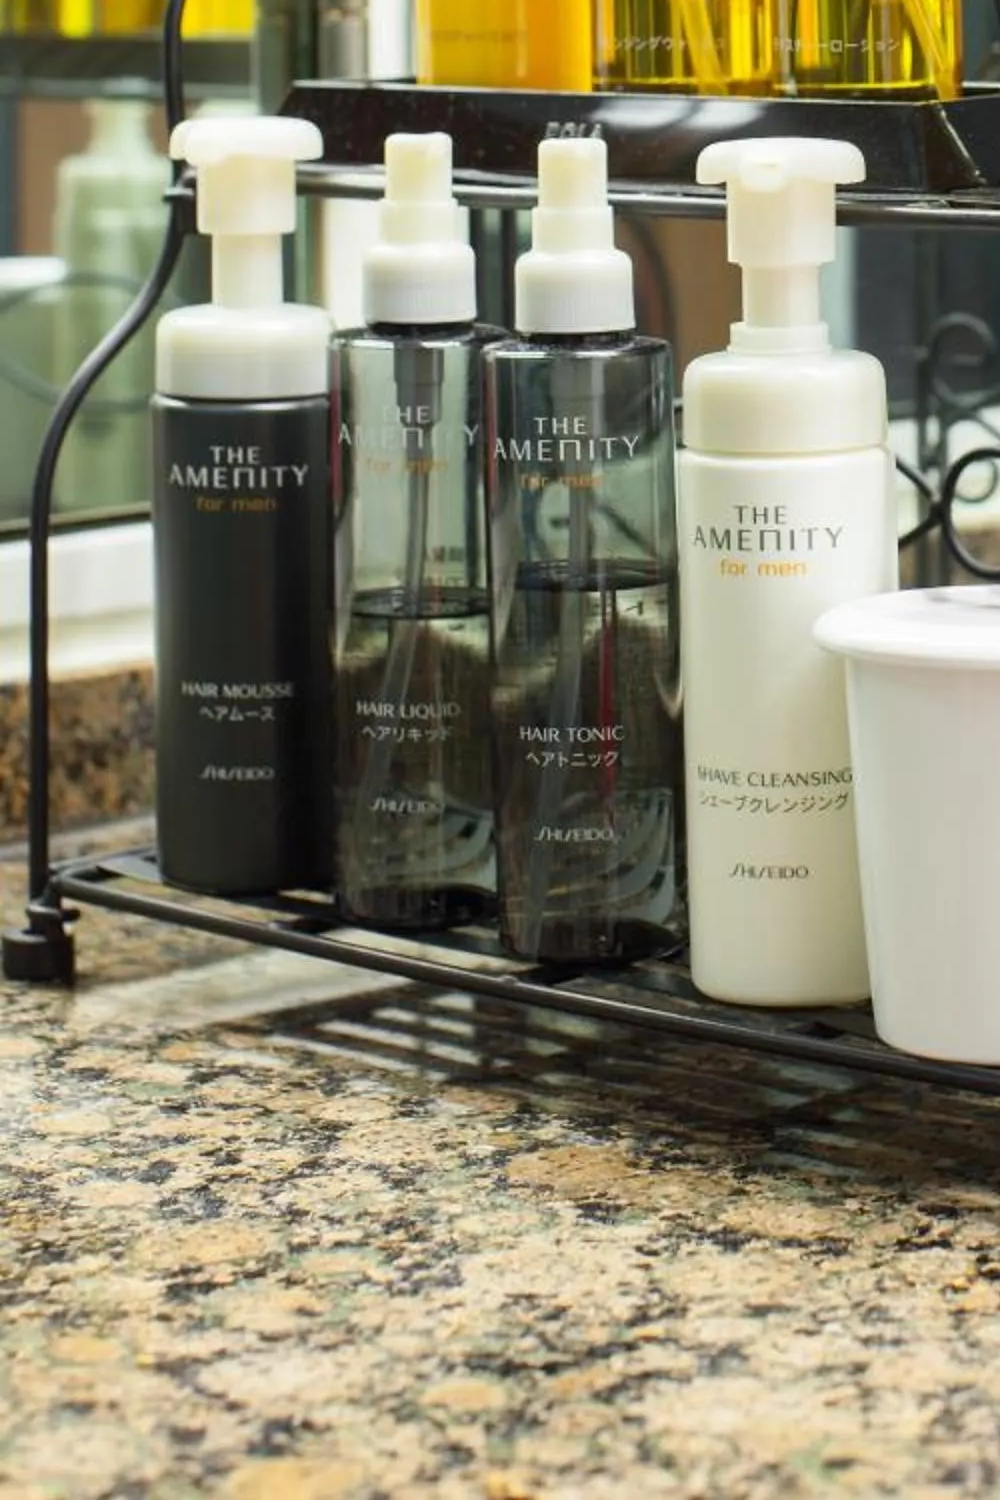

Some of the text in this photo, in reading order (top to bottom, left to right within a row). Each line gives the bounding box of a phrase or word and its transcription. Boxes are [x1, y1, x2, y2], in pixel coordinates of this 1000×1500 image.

[533, 416, 588, 436] THE
[209, 445, 262, 465] THE
[732, 504, 788, 526] THE
[719, 558, 808, 577] for men
[181, 680, 295, 699] HAIR MOUSSE
[200, 705, 276, 722] ヘアムース
[355, 700, 461, 720] HAIR LIQUID
[519, 725, 626, 743] HAIR TONIC
[525, 751, 619, 768] ヘアトニック
[747, 766, 853, 788] CLEANSING
